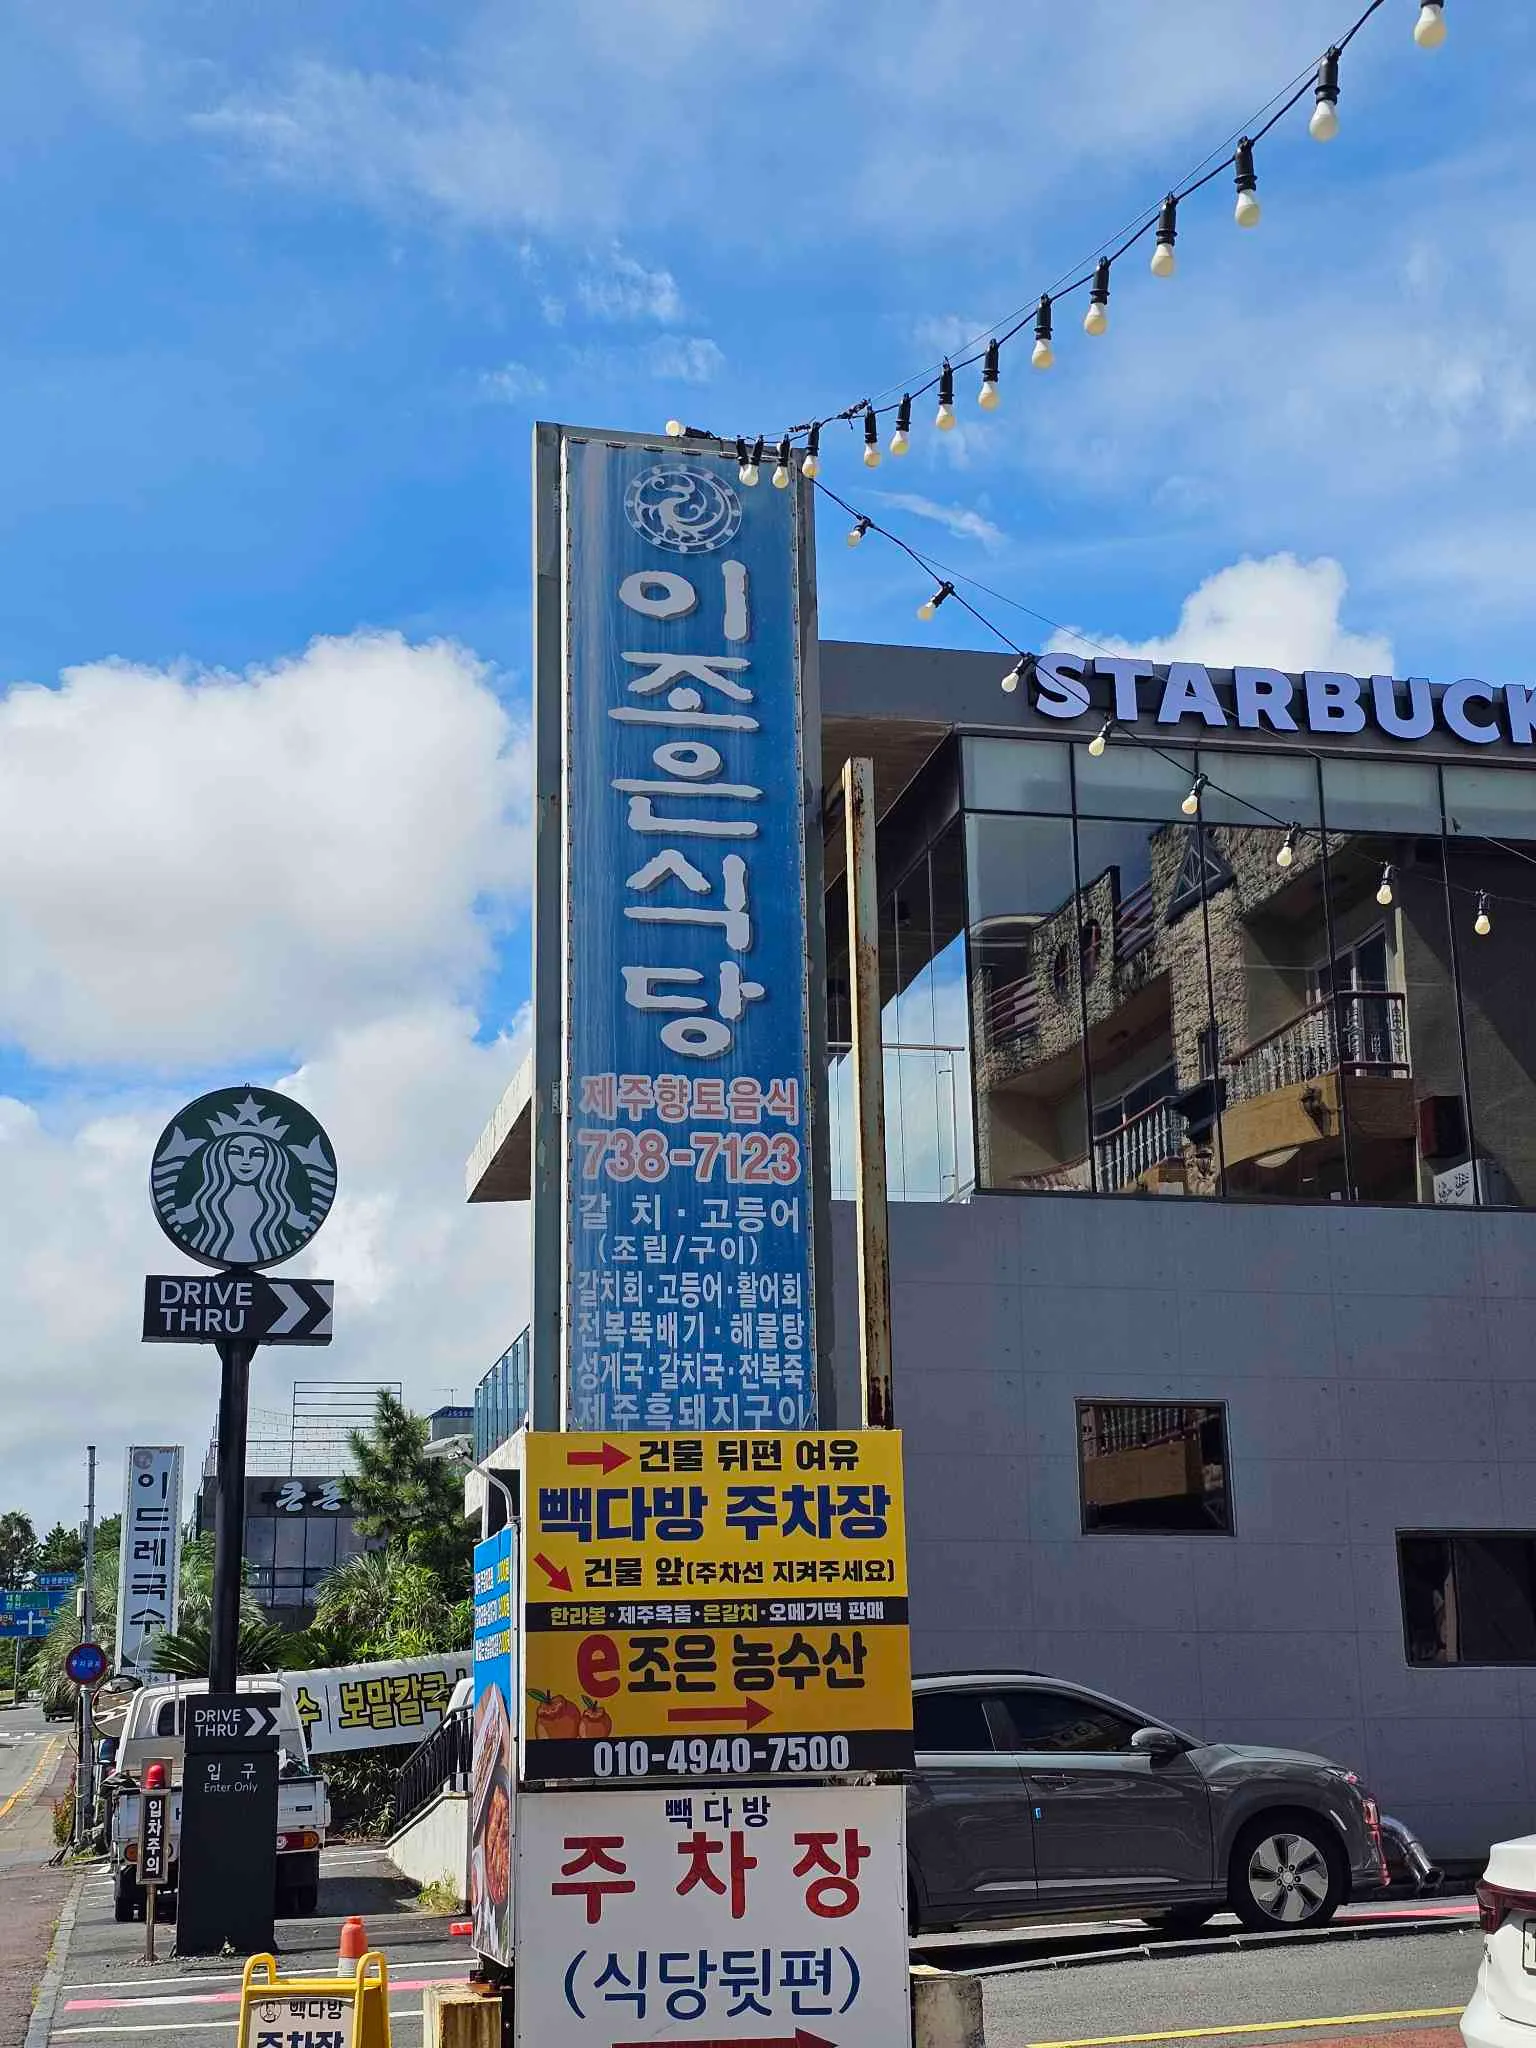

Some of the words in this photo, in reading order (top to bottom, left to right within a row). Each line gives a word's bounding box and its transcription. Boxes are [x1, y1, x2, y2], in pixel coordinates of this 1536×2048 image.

[607, 559, 765, 1058] 이조은식당
[579, 1072, 799, 1126] 제주향토음식
[577, 1128, 801, 1185] 738-7123
[599, 1234, 759, 1265] (조림/구이)
[160, 1280, 252, 1306] DRIVE
[159, 1308, 245, 1333] THRU
[576, 1393, 804, 1431] 제주흑돼지구이
[639, 1440, 703, 1472] 건물
[717, 1440, 782, 1472] 뒤편
[796, 1440, 859, 1472] 여유
[538, 1485, 708, 1542] 빽다방
[726, 1485, 891, 1541] 주차장
[584, 1558, 641, 1588] 건물
[773, 1559, 895, 1584] 지켜주세요)
[848, 1601, 884, 1621] 판매
[194, 1724, 238, 1737] THRU
[195, 1709, 241, 1722] DRIVE
[593, 1735, 849, 1777] 010-4940-7500
[204, 1782, 231, 1793] Enter
[234, 1781, 258, 1793] Only
[665, 1795, 771, 1829] 빽다방
[146, 1800, 162, 1875] 입차주의
[551, 1828, 871, 1924] 주차장
[564, 1945, 860, 2020] (식당뒷편)
